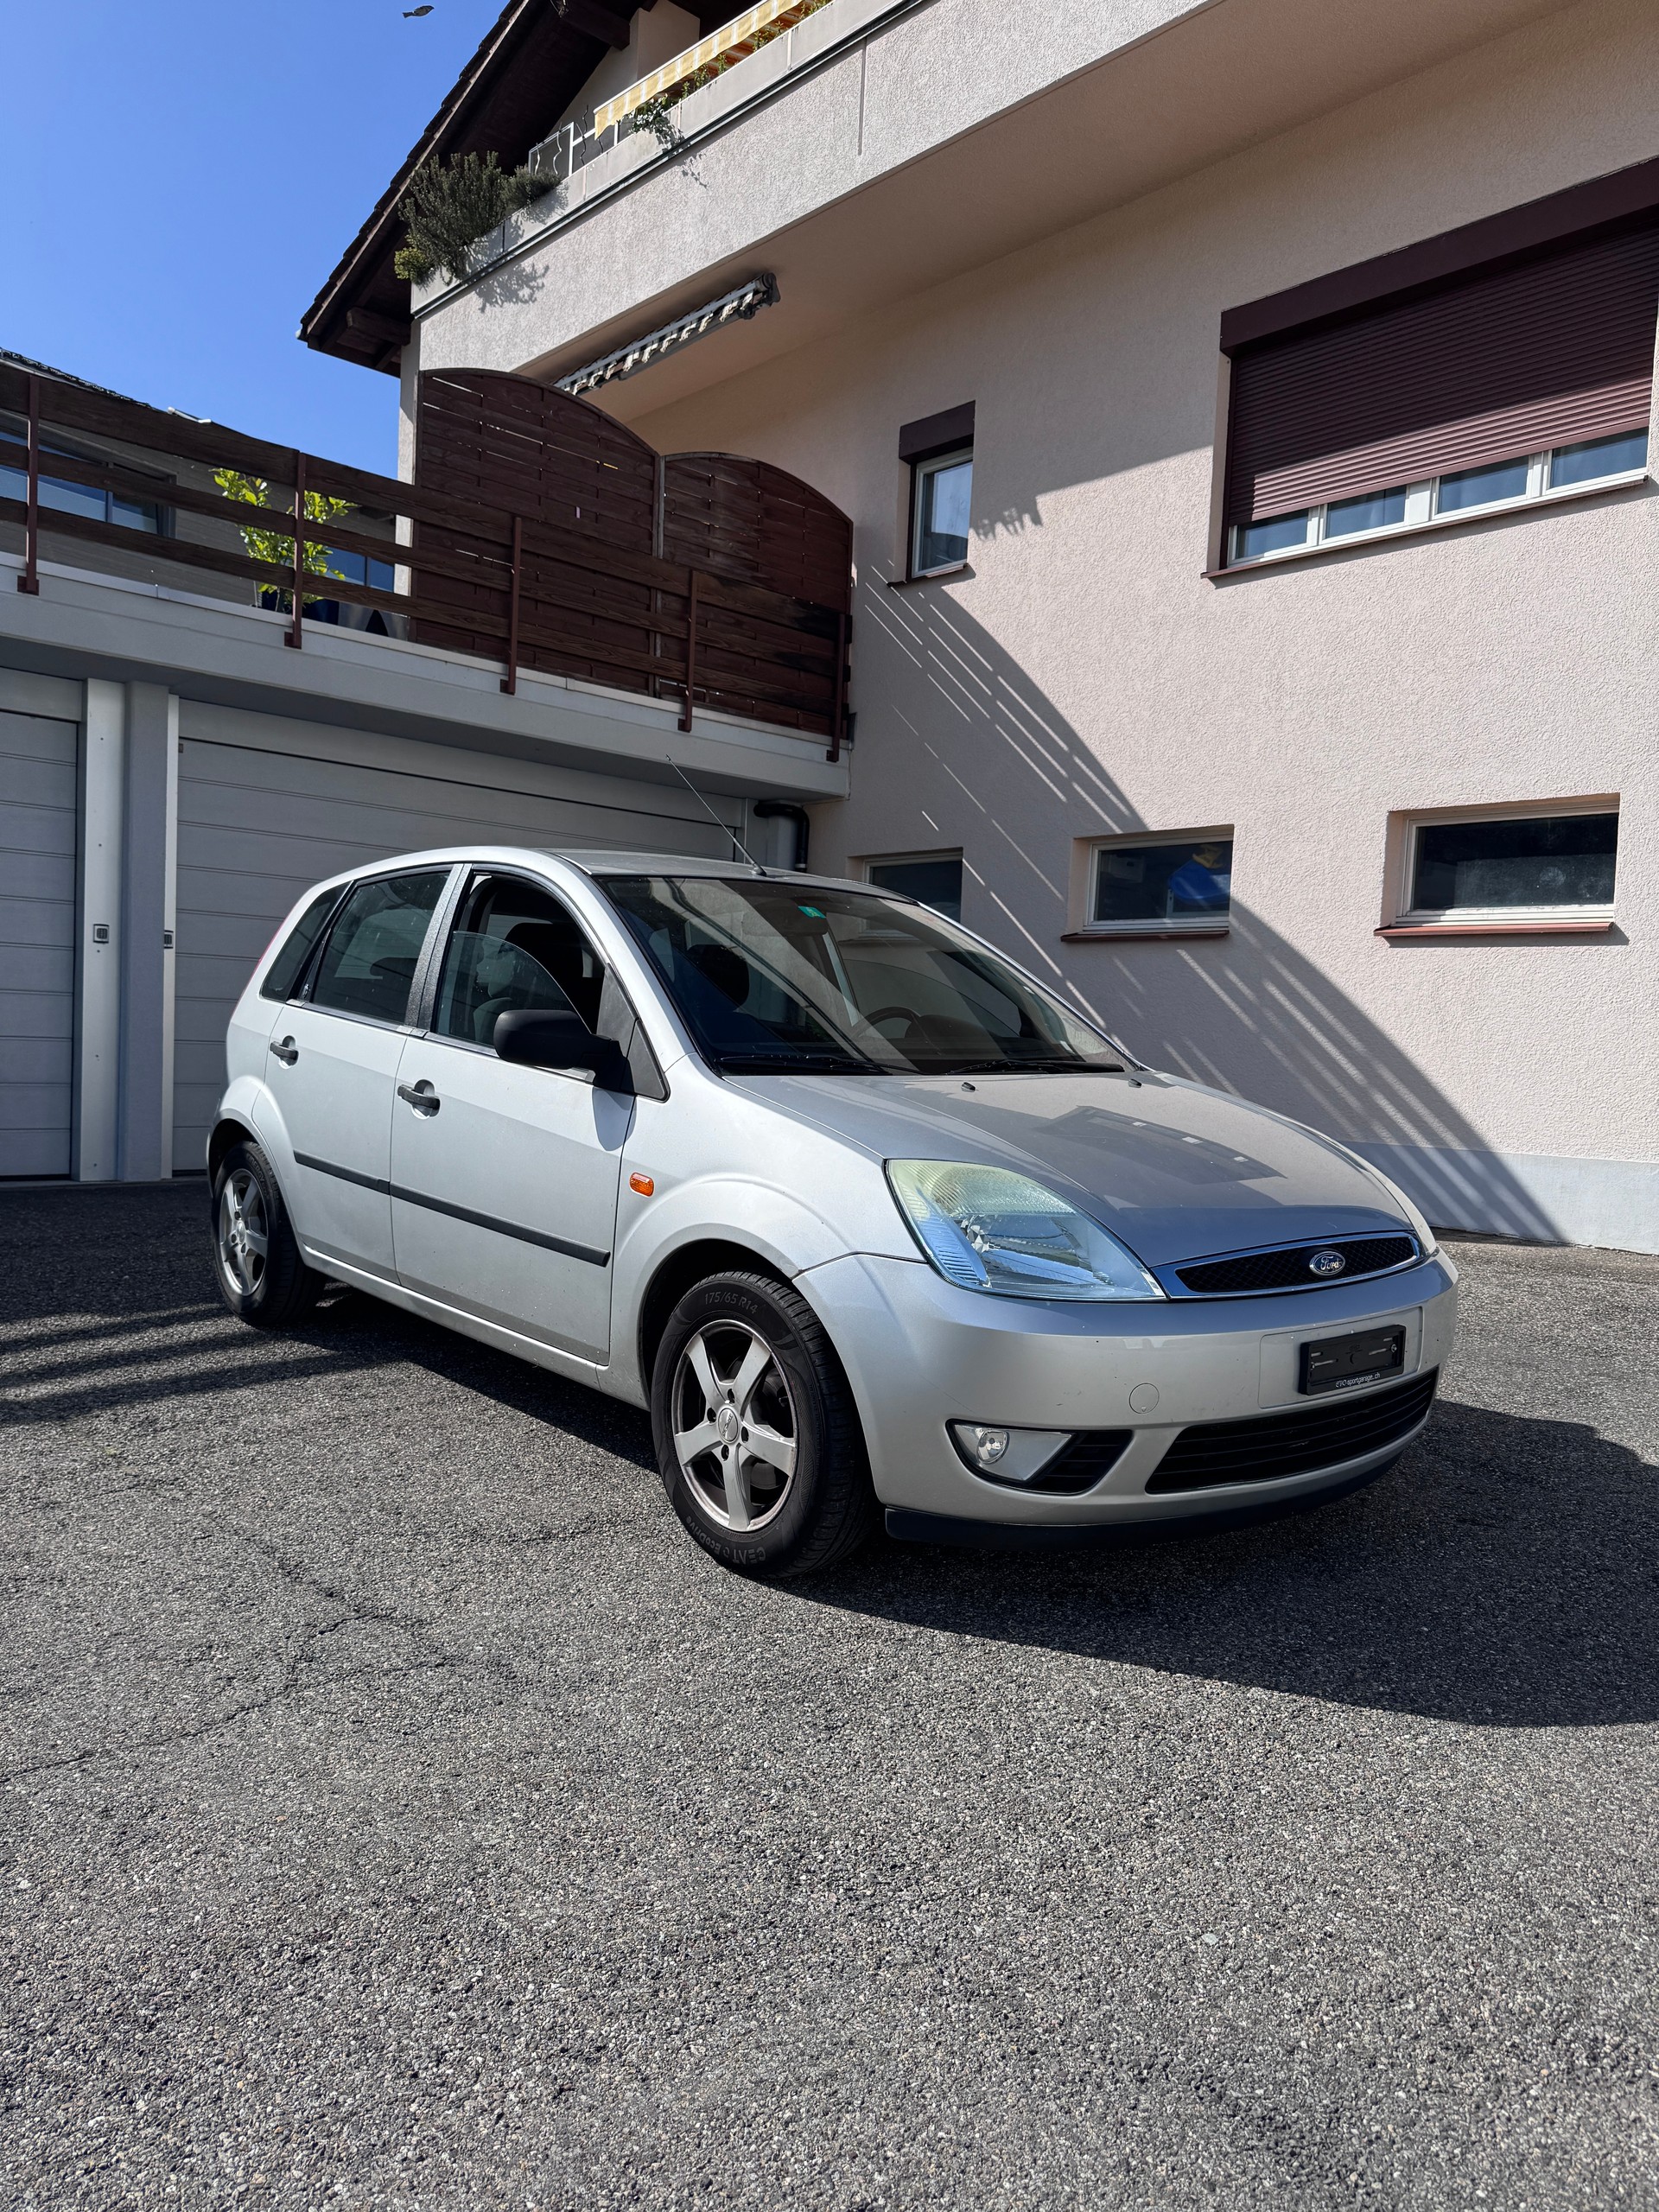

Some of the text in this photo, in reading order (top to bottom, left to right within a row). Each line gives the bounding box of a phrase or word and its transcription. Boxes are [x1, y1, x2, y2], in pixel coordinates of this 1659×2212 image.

[1320, 1255, 1340, 1270] Ford
[705, 1291, 759, 1314] 175/65 R14
[686, 1516, 722, 1555] EcoDrive
[732, 1546, 766, 1565] CEAT
